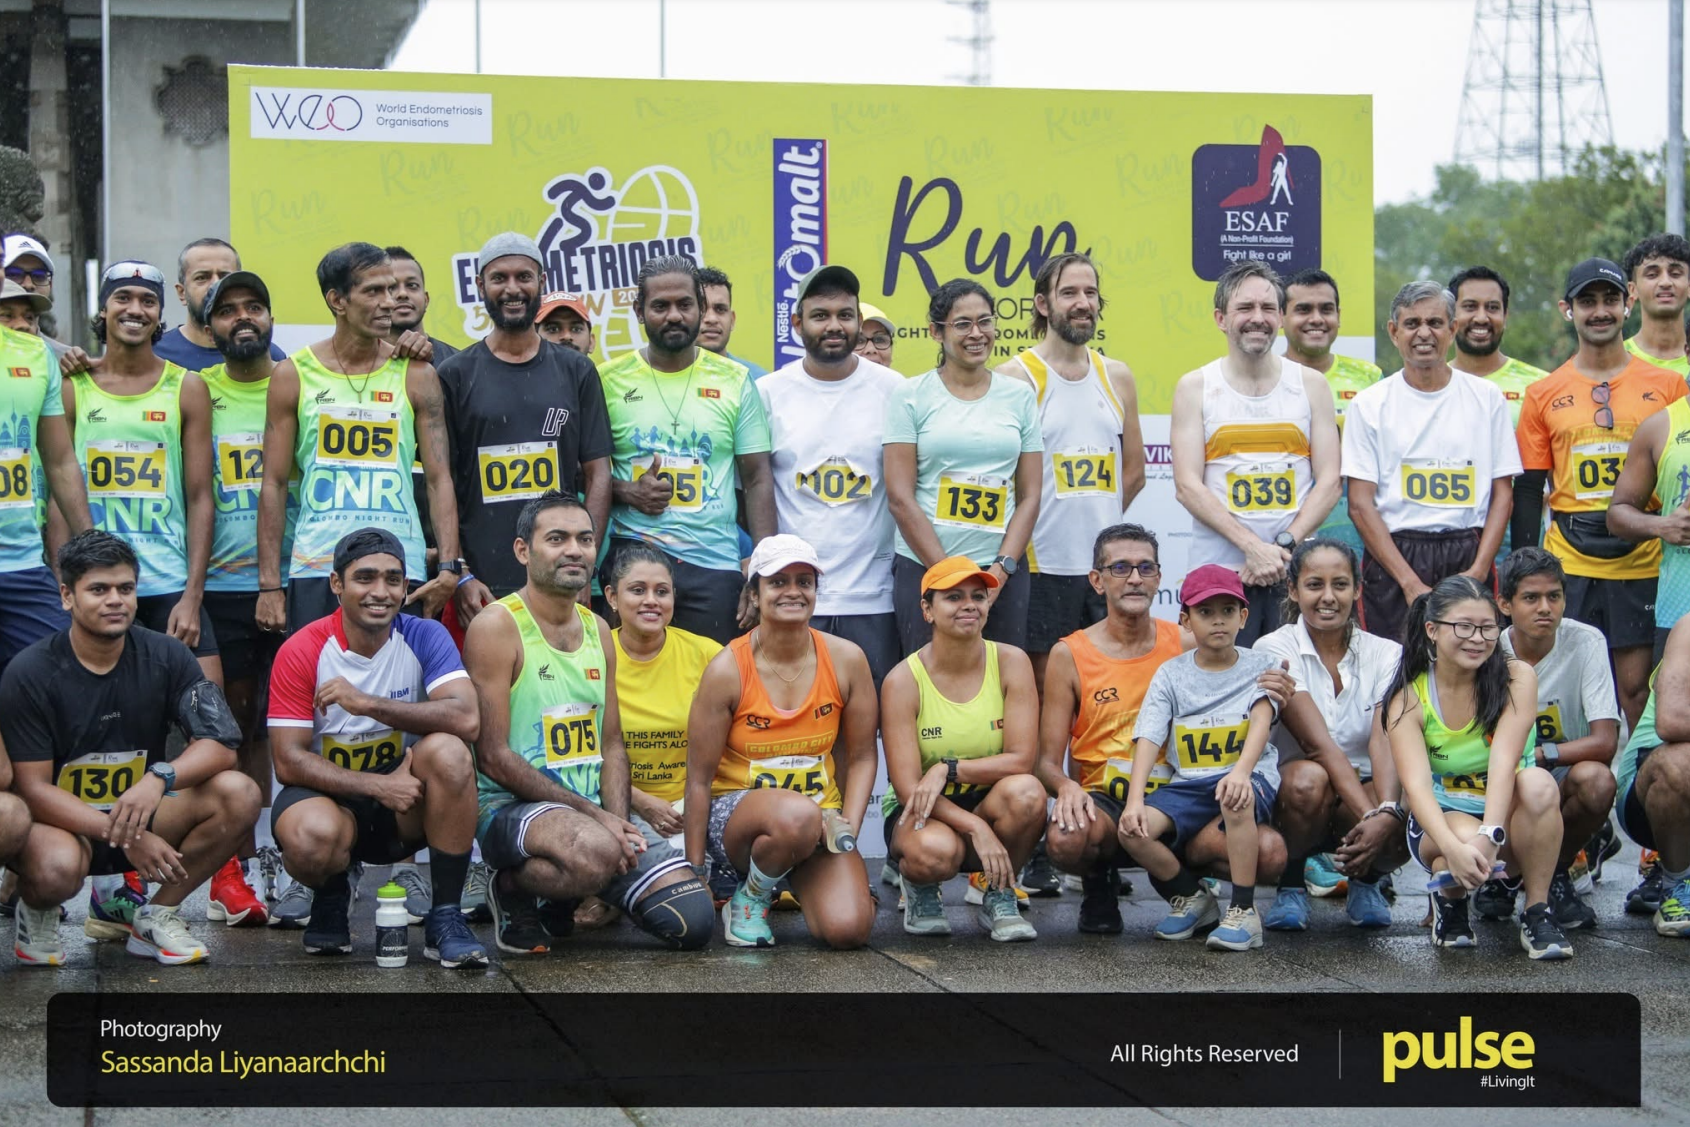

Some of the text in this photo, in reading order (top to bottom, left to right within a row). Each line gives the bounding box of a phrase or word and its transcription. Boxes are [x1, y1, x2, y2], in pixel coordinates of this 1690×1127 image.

[376, 103, 483, 116] World Endometriosis
[376, 116, 449, 128] Organisations
[1224, 211, 1290, 232] ESAF
[1228, 234, 1258, 244] Non-Profit
[1259, 235, 1294, 244] Foundation)
[1223, 250, 1292, 262] Fight like a girl
[1552, 395, 1574, 408] CCR
[323, 423, 393, 458] 005
[91, 456, 162, 488] 054
[229, 449, 263, 480] 12
[485, 457, 554, 492] 020
[1061, 459, 1112, 488] 124
[307, 469, 405, 512] CNR
[1232, 477, 1291, 508] 039
[1406, 473, 1470, 502] 065
[948, 487, 1000, 522] 133
[1094, 687, 1118, 702] CCR
[626, 730, 684, 739] THIS FAMILY
[746, 714, 771, 728] CCR
[921, 727, 942, 737] CNR
[551, 719, 595, 756] 075
[634, 741, 667, 749] FIGHTS
[1181, 730, 1245, 763] 144
[328, 741, 396, 771] 078
[68, 767, 133, 800] 130
[633, 771, 672, 780] Sri Lanka
